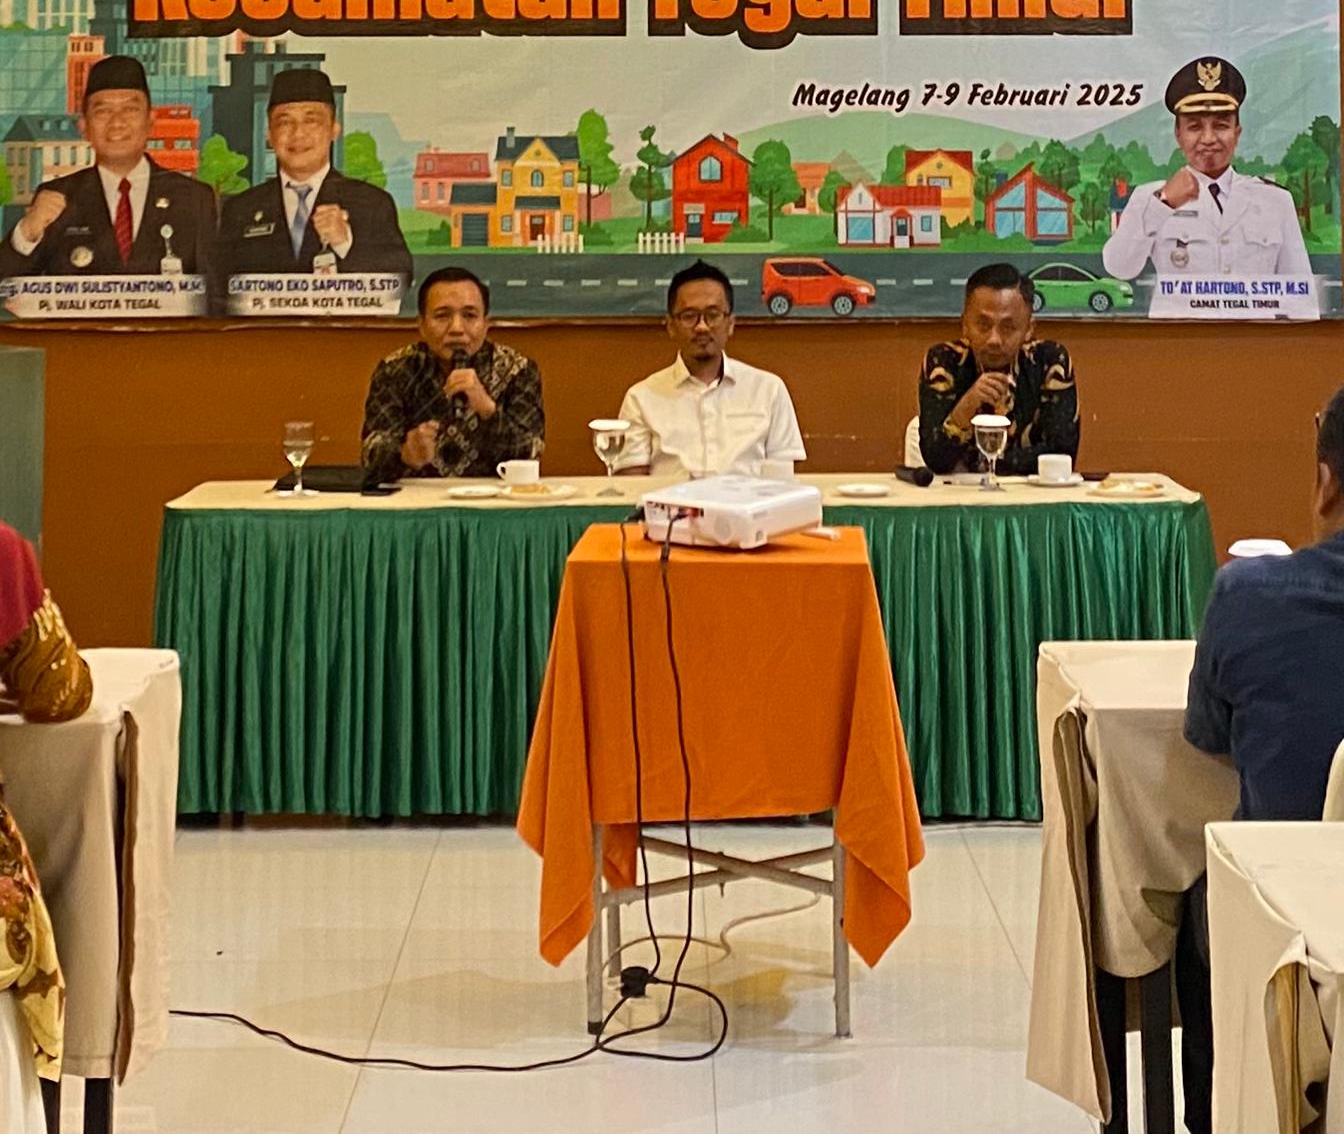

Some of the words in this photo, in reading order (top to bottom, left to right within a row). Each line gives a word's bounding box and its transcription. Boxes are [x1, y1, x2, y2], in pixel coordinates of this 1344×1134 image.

[792, 82, 910, 114] Magelang
[921, 83, 960, 106] 7-9
[967, 82, 1071, 106] Februari
[1076, 83, 1144, 106] 2025
[21, 281, 52, 294] AGUS
[55, 280, 79, 293] DWI
[229, 279, 284, 292] SARTONO
[286, 279, 307, 291] EKO
[311, 279, 367, 293] SAPUTRO,
[1195, 281, 1249, 297] HARTONO,
[1251, 281, 1284, 296] S.STP,
[56, 299, 87, 311] WALI
[89, 299, 122, 310] KOTA
[125, 299, 161, 310] TEGAL
[269, 297, 309, 308] SEKDA
[312, 297, 343, 308] KOTA
[347, 297, 384, 308] TEGAL
[1190, 300, 1220, 309] CAMAT
[1223, 300, 1250, 309] TEGAL
[1252, 300, 1280, 309] TIMUR
